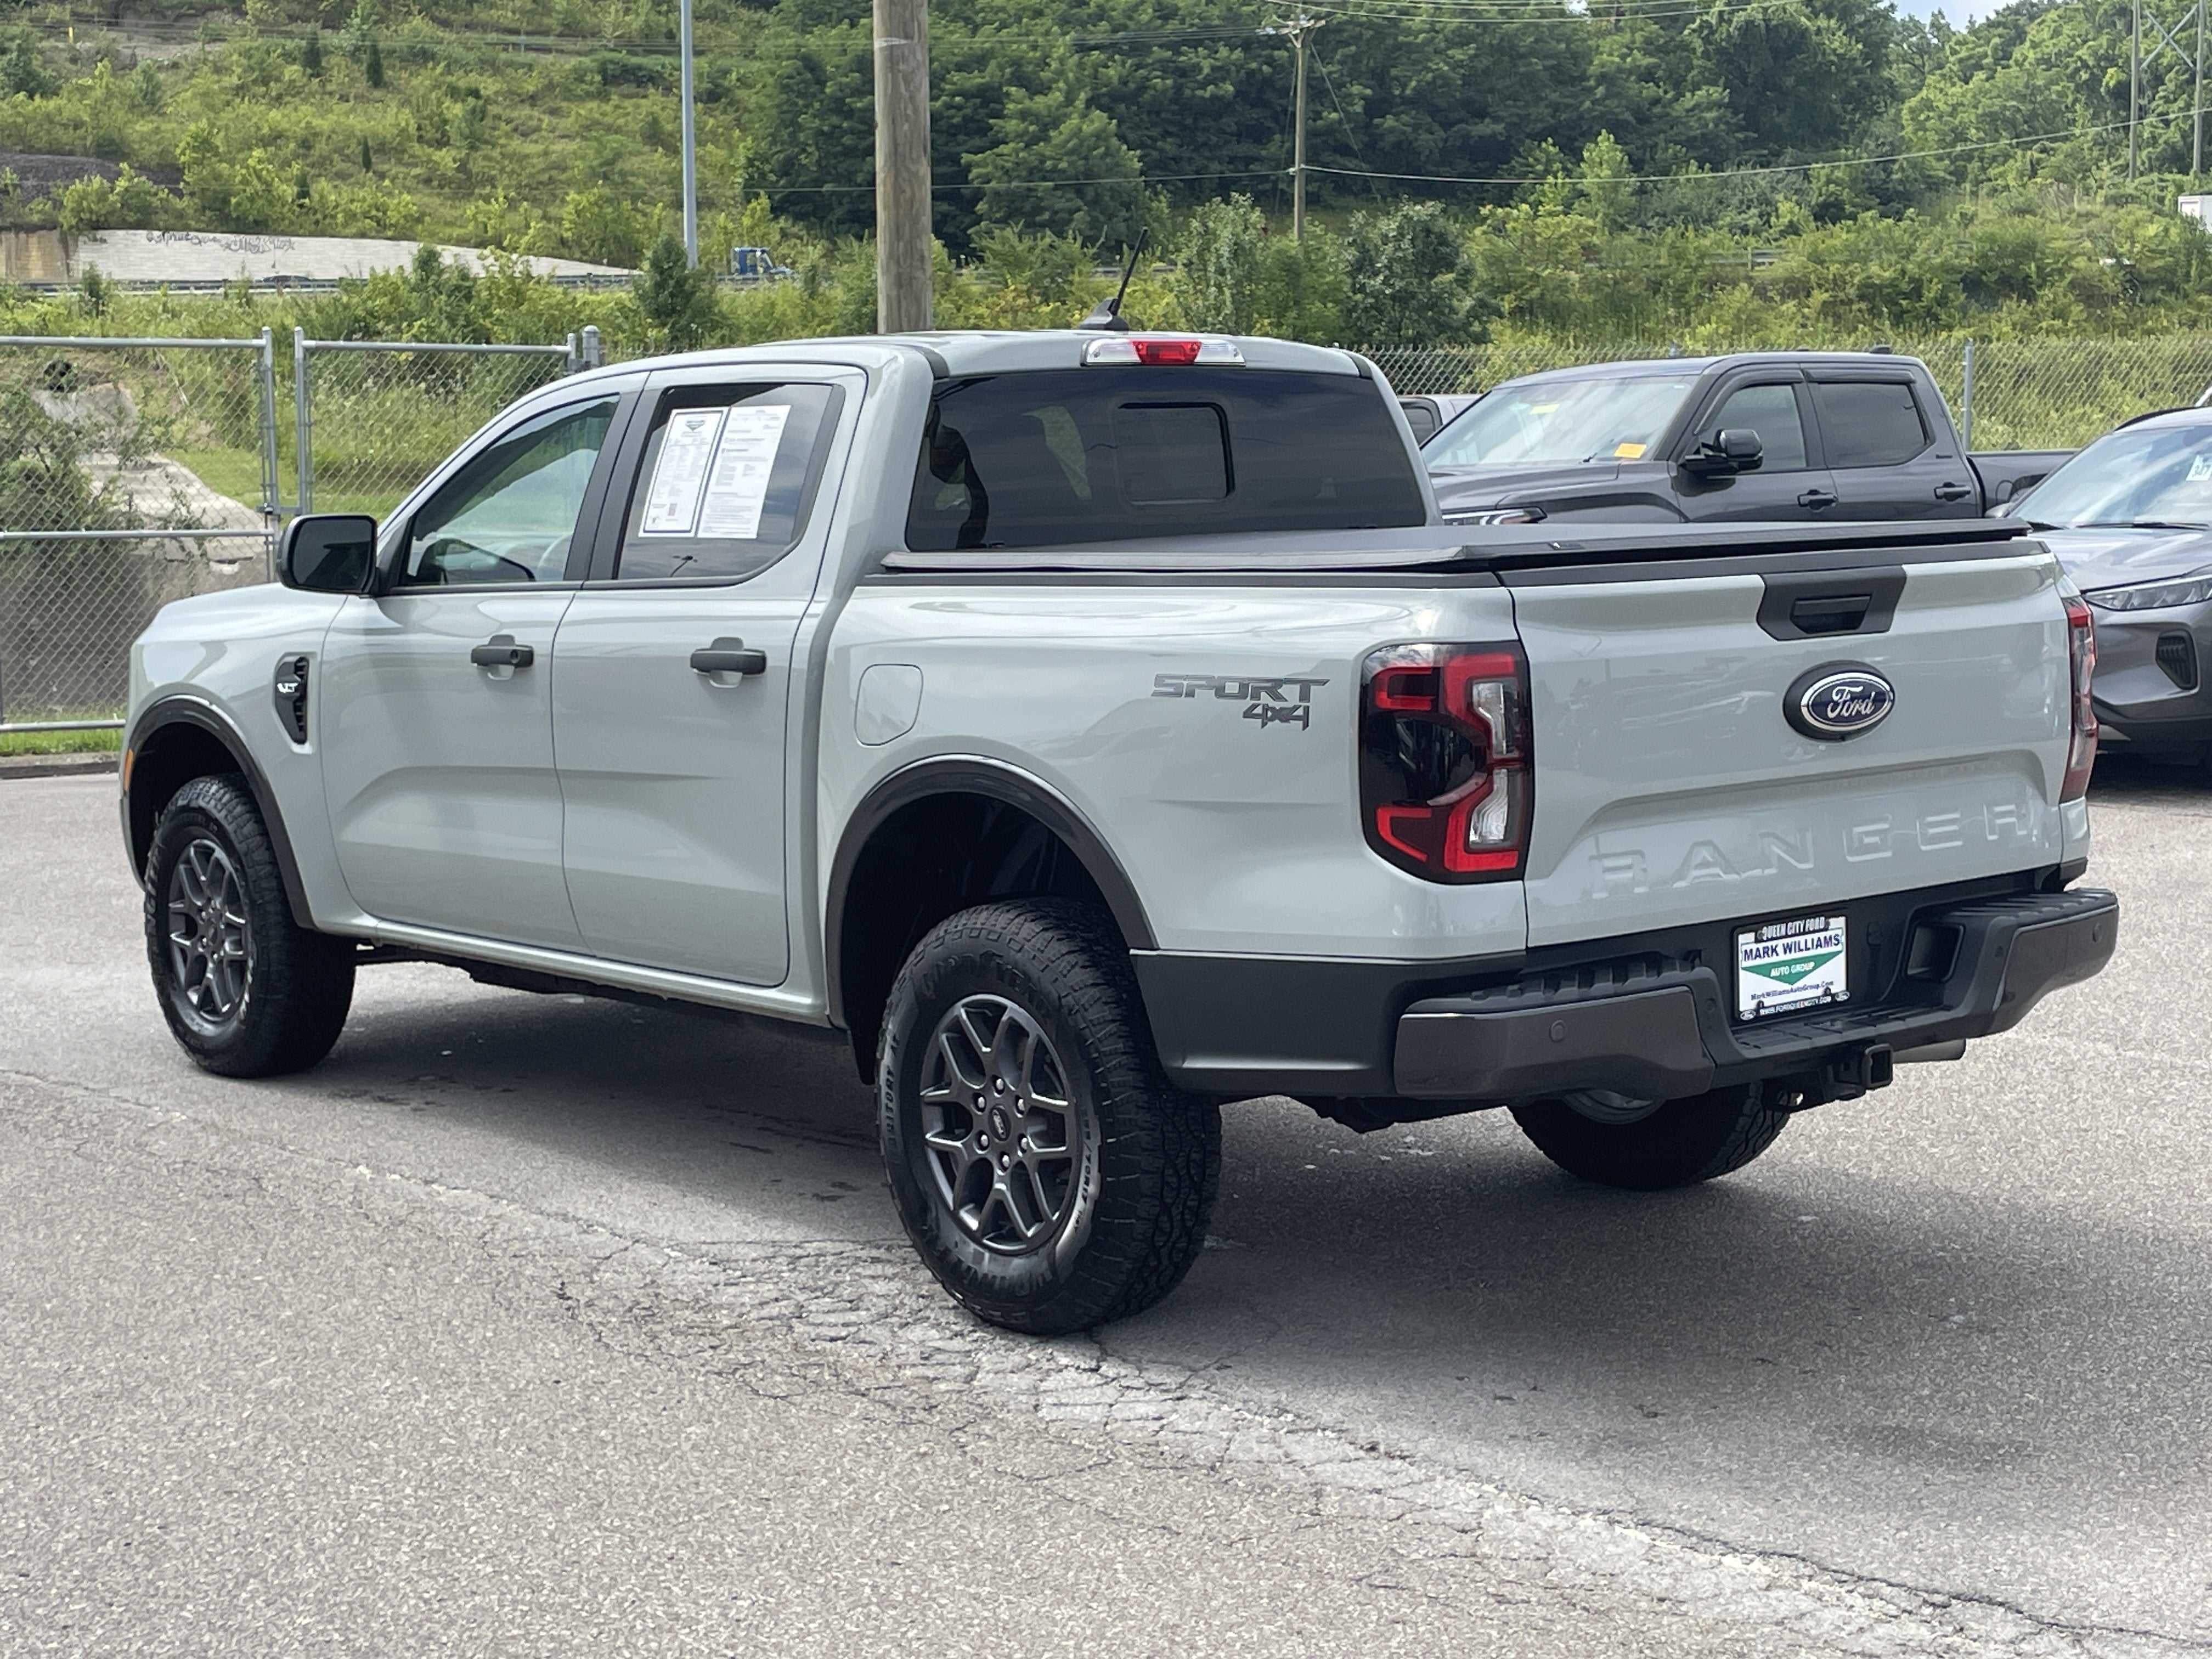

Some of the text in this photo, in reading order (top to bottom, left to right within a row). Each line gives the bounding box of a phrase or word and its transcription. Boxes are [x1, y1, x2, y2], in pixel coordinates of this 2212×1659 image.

[1151, 673, 1330, 703] SPORT
[1827, 686, 1875, 718] Ford
[1589, 803, 2029, 899] RANGER
[1787, 919, 1805, 935] CITY
[1805, 916, 1825, 932] FORD
[1743, 933, 1840, 962] MARK WILLIAMS
[1770, 961, 1815, 977] AUTO GROUP
